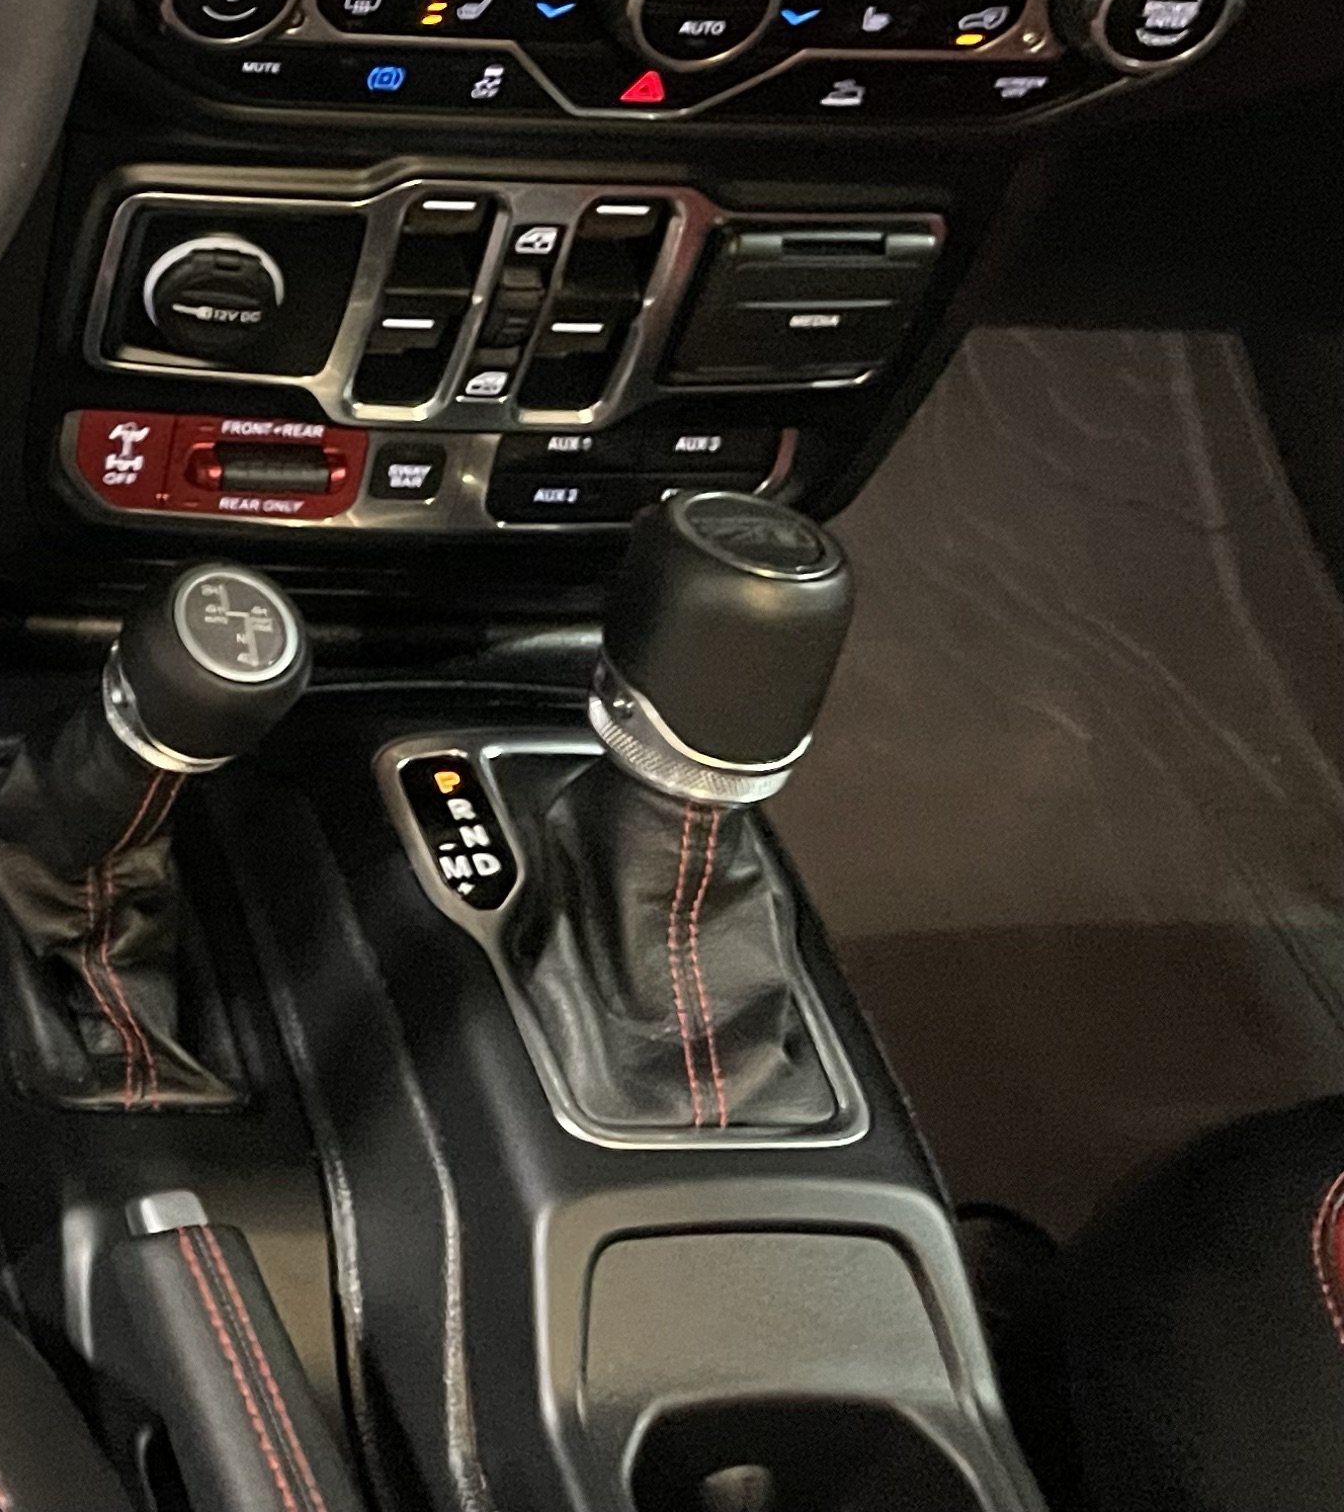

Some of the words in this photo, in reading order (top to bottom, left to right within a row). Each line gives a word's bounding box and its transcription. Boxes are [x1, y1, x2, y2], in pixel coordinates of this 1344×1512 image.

[678, 20, 726, 37] AUTO
[241, 61, 281, 74] MUTE
[214, 309, 240, 322] 12V
[547, 436, 581, 451] AUX
[675, 436, 707, 451] AUX
[102, 471, 139, 486] OFF
[533, 488, 565, 502] AUX
[218, 497, 260, 512] REAR
[262, 499, 305, 513] ONLY
[236, 633, 247, 644] N
[434, 771, 461, 794] P
[446, 798, 476, 821] R
[459, 824, 490, 848] N
[439, 855, 473, 880] M
[472, 852, 502, 877] D
